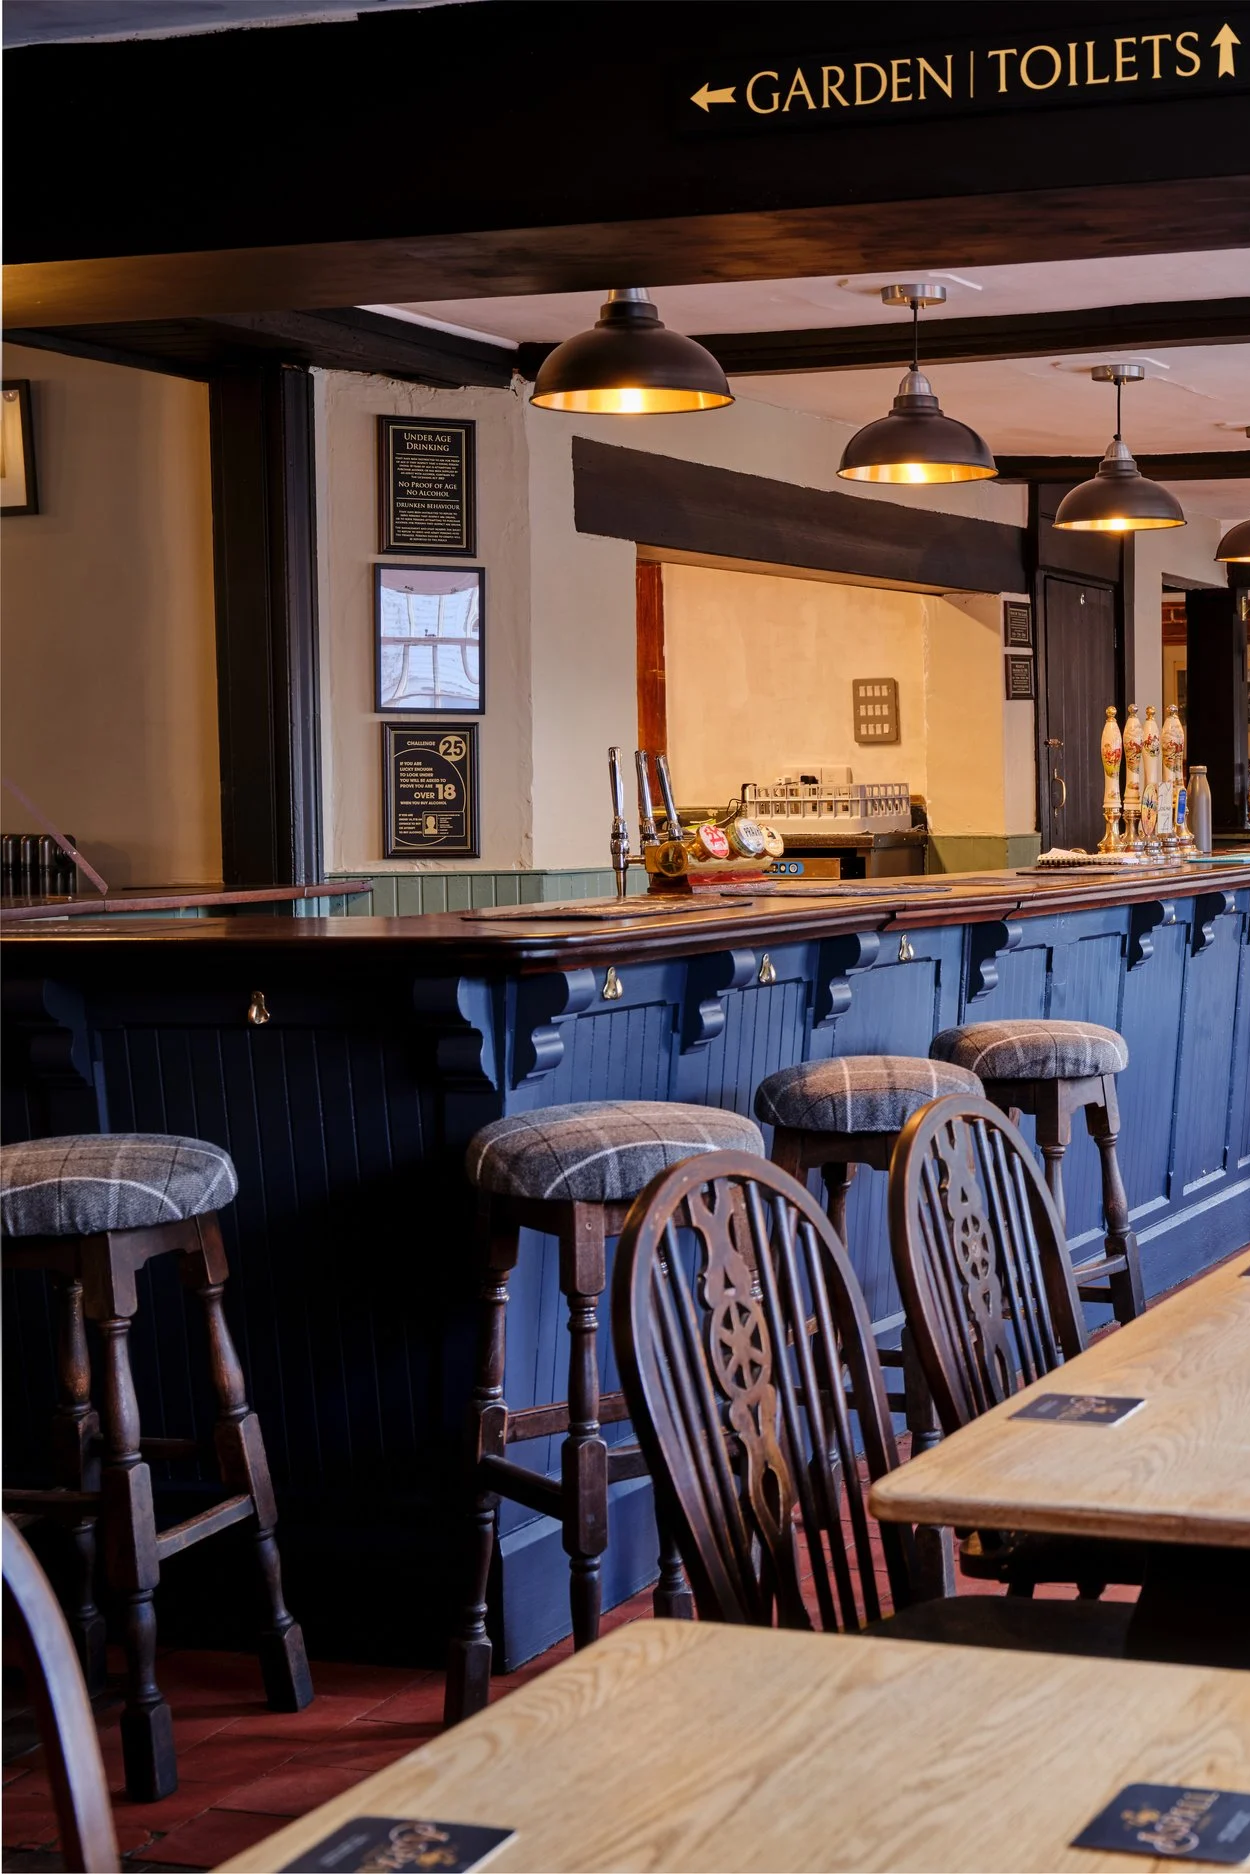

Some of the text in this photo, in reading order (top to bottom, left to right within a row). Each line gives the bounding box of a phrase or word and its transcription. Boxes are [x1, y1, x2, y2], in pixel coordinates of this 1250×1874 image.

[987, 31, 1201, 93] TOILETS
[746, 55, 953, 114] GARDEN
[403, 432, 452, 443] UNDER AGE
[406, 441, 450, 452] DRINKING
[411, 481, 433, 489] PROOF
[396, 501, 426, 509] DRUNKEN
[441, 740, 464, 757] 25
[435, 783, 457, 800] 18
